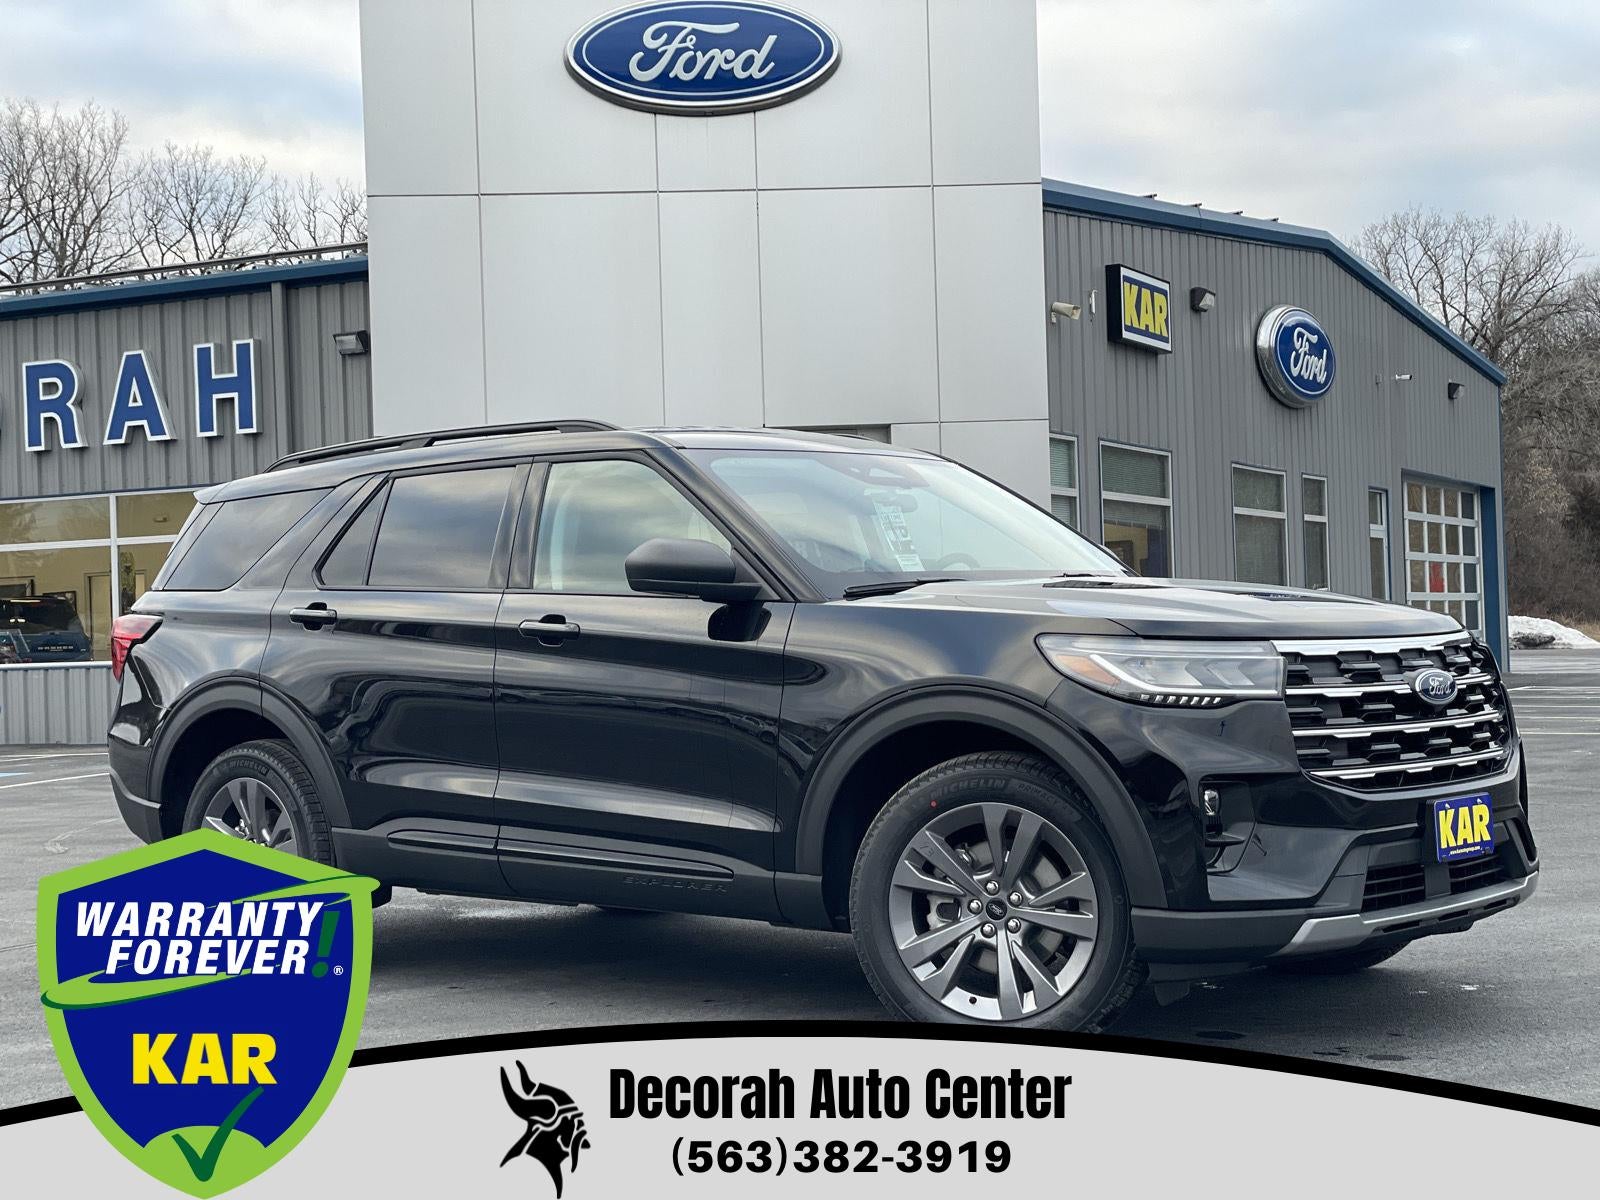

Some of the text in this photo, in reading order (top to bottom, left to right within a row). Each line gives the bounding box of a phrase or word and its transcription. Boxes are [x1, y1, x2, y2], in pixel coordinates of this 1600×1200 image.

[629, 21, 777, 81] Ford
[1123, 281, 1168, 337] KAR
[1290, 327, 1327, 384] Ford
[1429, 677, 1452, 696] Ford
[229, 759, 269, 775] MICHELIN
[929, 778, 1006, 799] MICHELIN
[1438, 804, 1491, 849] KAR
